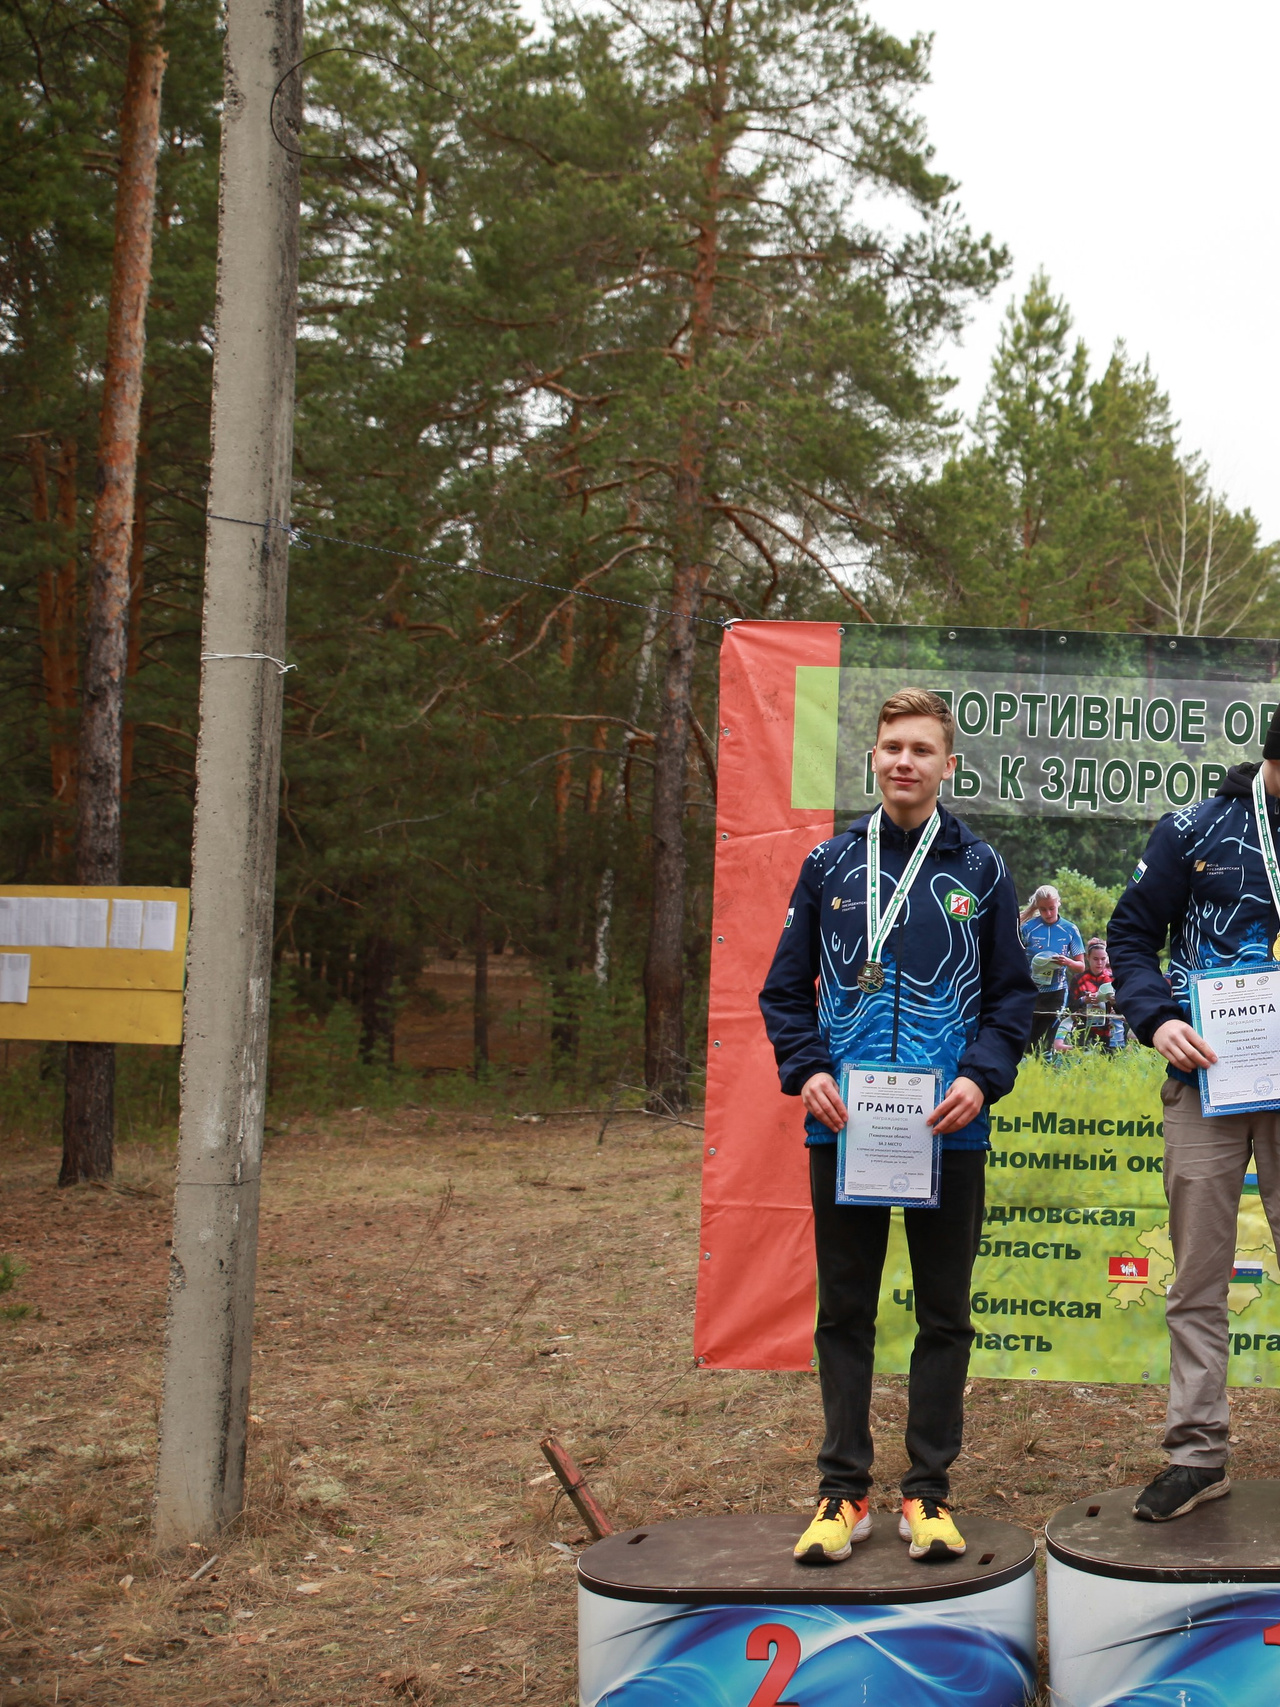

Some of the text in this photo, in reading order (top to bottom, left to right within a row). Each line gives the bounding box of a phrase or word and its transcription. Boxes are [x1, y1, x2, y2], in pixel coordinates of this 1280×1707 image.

[928, 690, 1206, 744] ОРТИВНОЕ
[999, 754, 1026, 800] К
[1039, 756, 1228, 811] ЗДОРОВ
[1210, 1003, 1276, 1019] ГРАМОТА
[857, 1102, 923, 1114] ГРАМОТА
[977, 1235, 1082, 1261] бласть
[746, 1622, 802, 1707] 2
